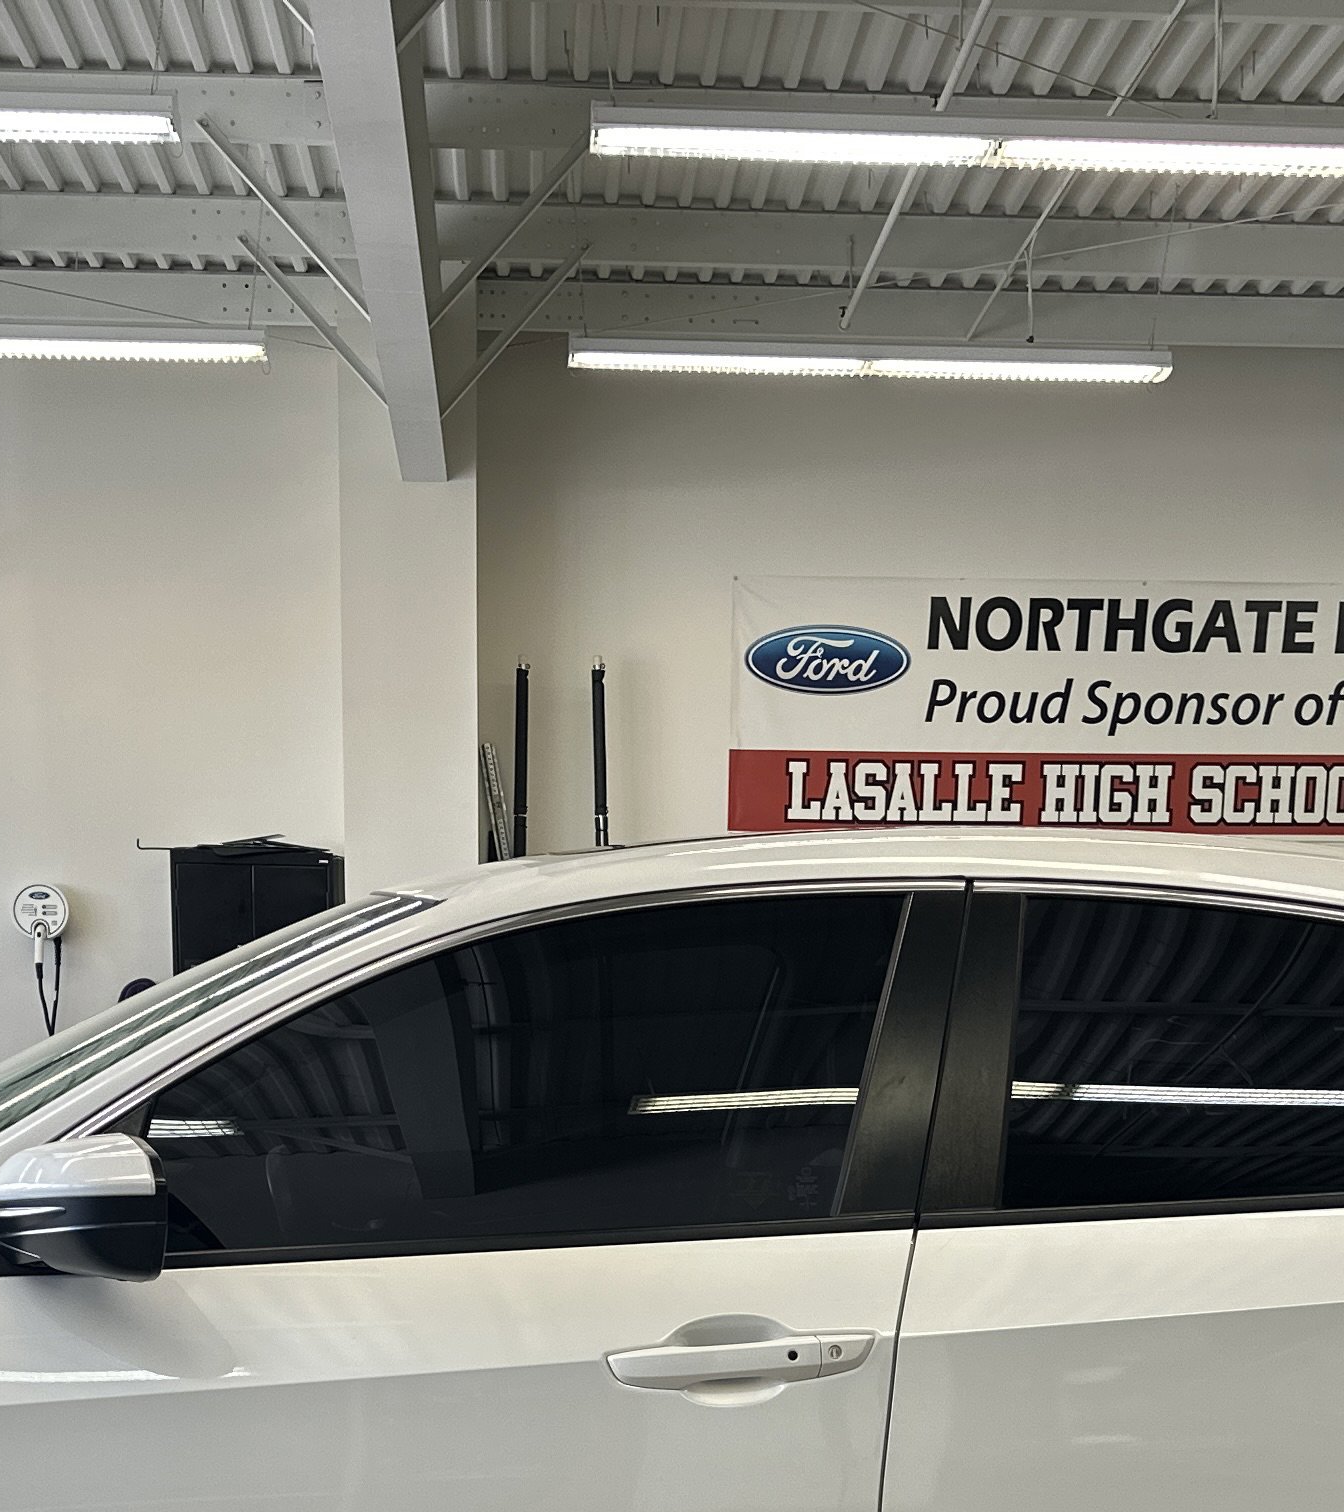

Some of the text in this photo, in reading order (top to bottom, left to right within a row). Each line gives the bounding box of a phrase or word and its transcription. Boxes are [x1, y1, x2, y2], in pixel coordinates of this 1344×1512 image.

[926, 595, 1319, 654] NORTHGATE
[775, 635, 881, 683] Ford
[924, 677, 1075, 724] Proud
[1081, 679, 1286, 737] Sponsor
[785, 759, 1026, 824] LASALLE
[1039, 762, 1174, 825] HIGH
